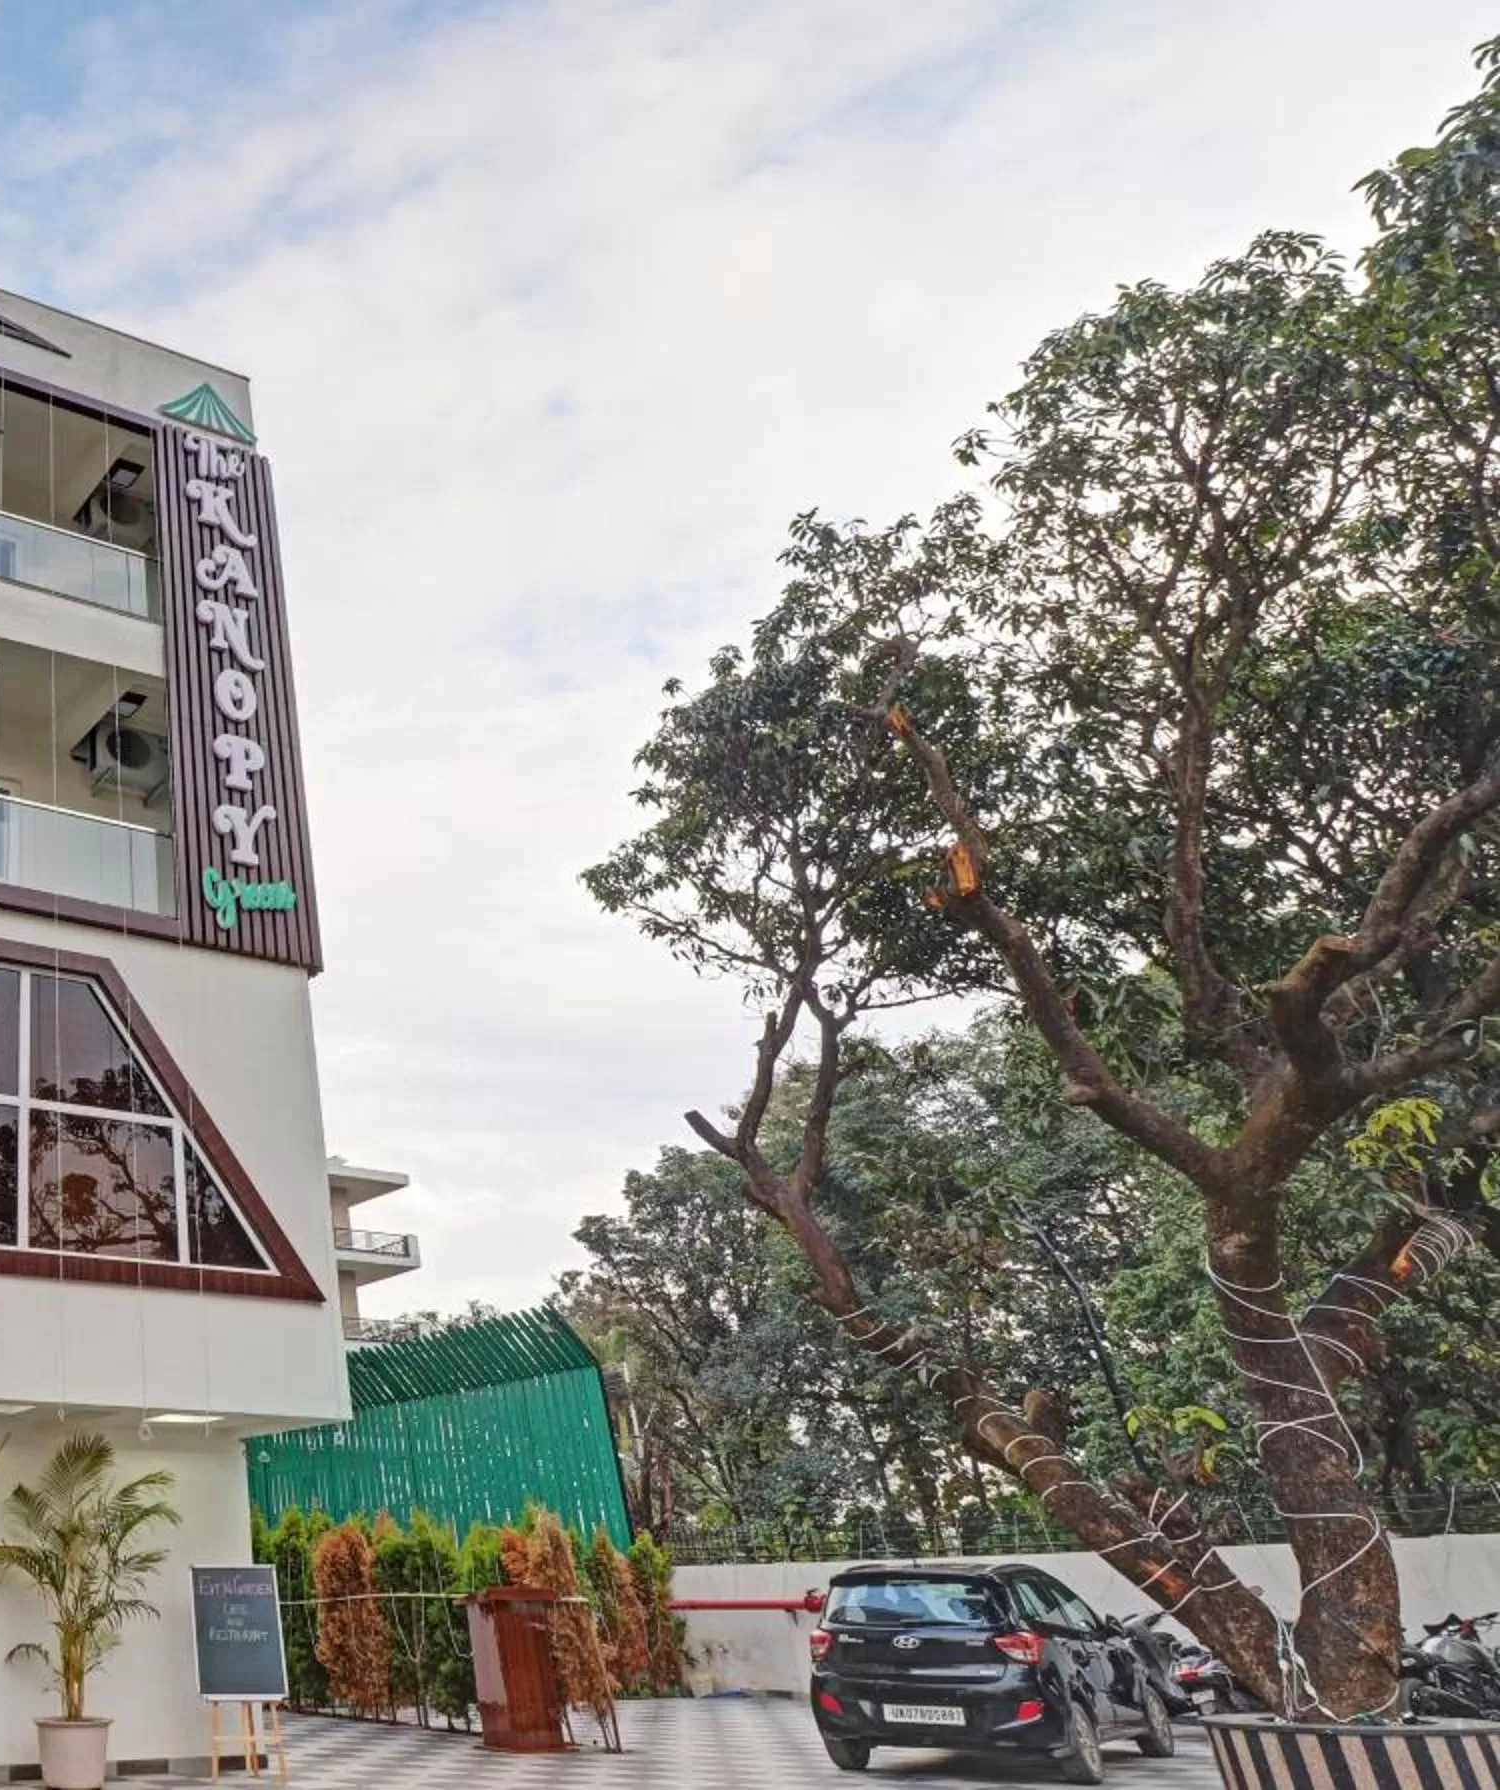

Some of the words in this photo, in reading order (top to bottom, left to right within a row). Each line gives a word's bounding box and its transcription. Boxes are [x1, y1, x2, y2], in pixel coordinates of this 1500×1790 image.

[184, 434, 245, 479] The
[186, 479, 276, 867] KANOPY
[203, 865, 296, 929] Green
